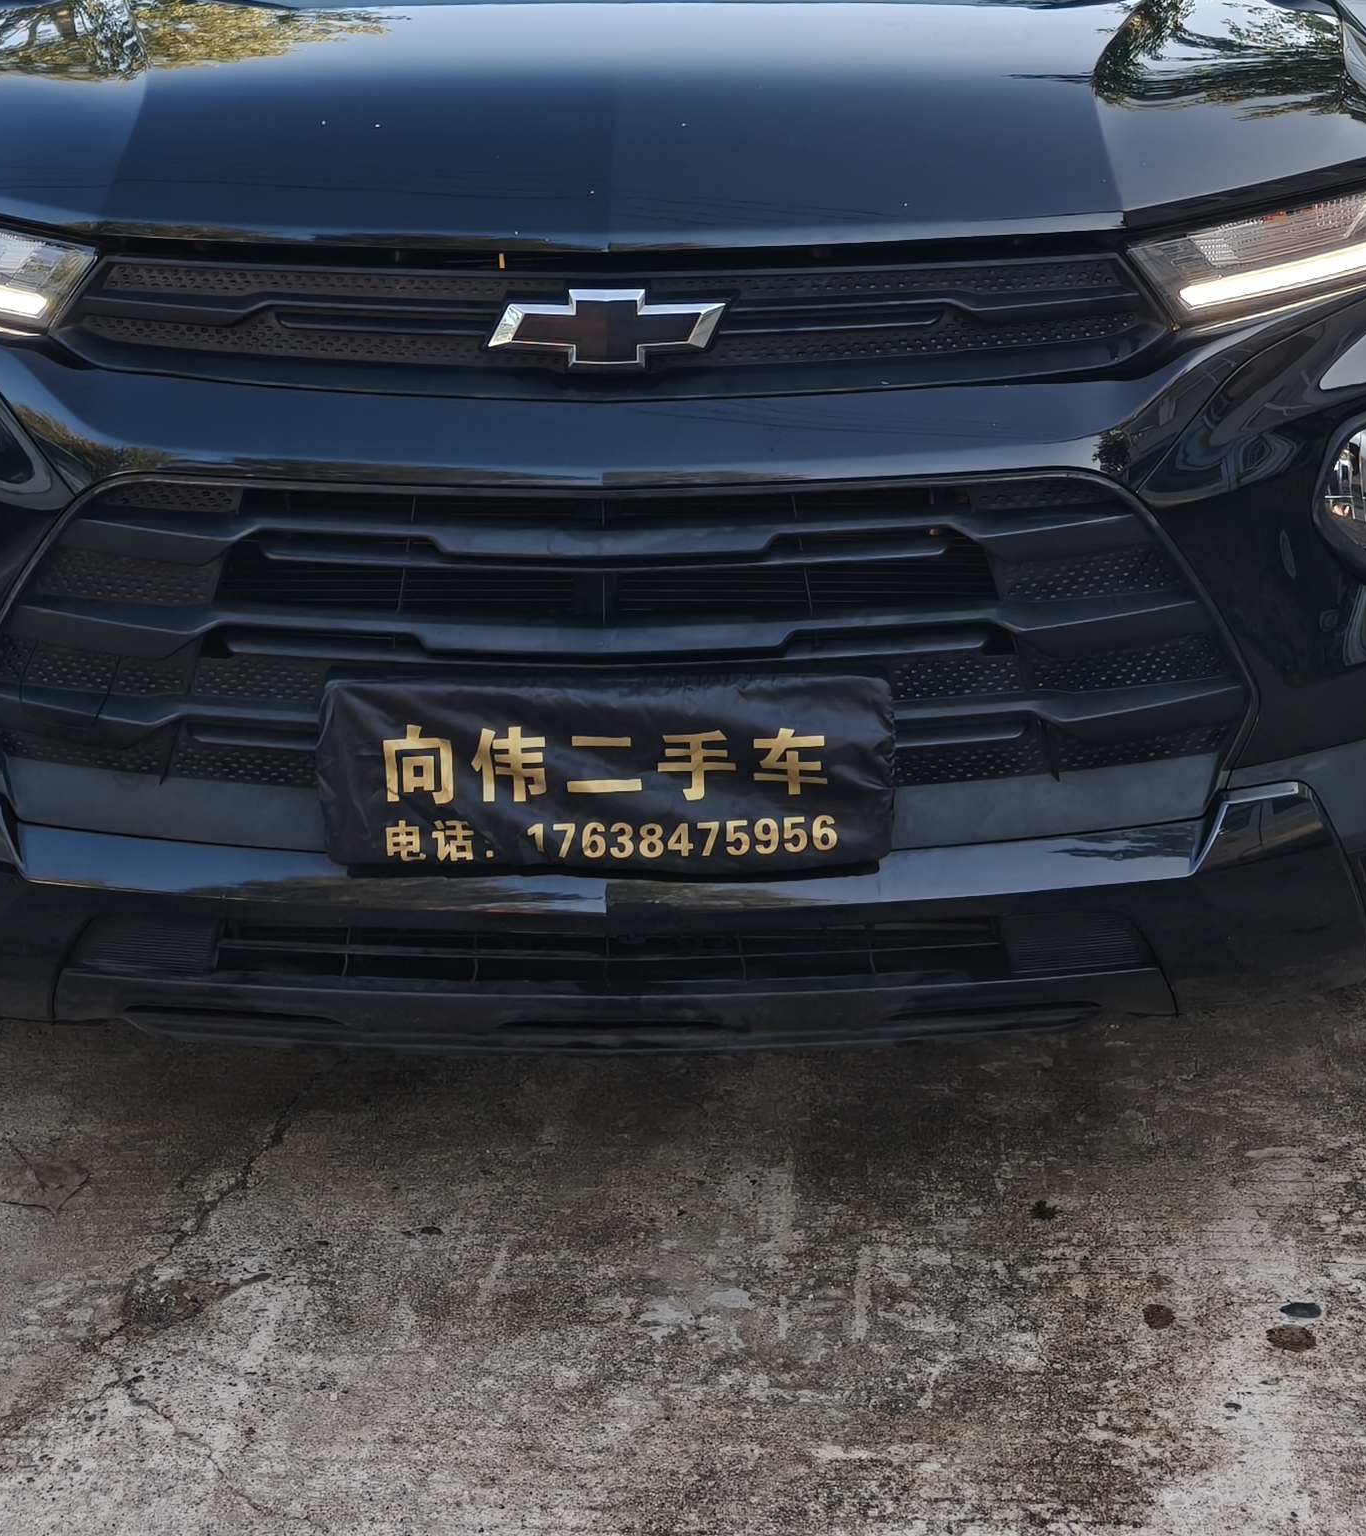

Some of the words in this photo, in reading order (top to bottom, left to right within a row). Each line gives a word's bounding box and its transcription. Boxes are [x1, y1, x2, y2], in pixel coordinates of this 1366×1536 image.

[382, 724, 828, 804] 向伟二手车
